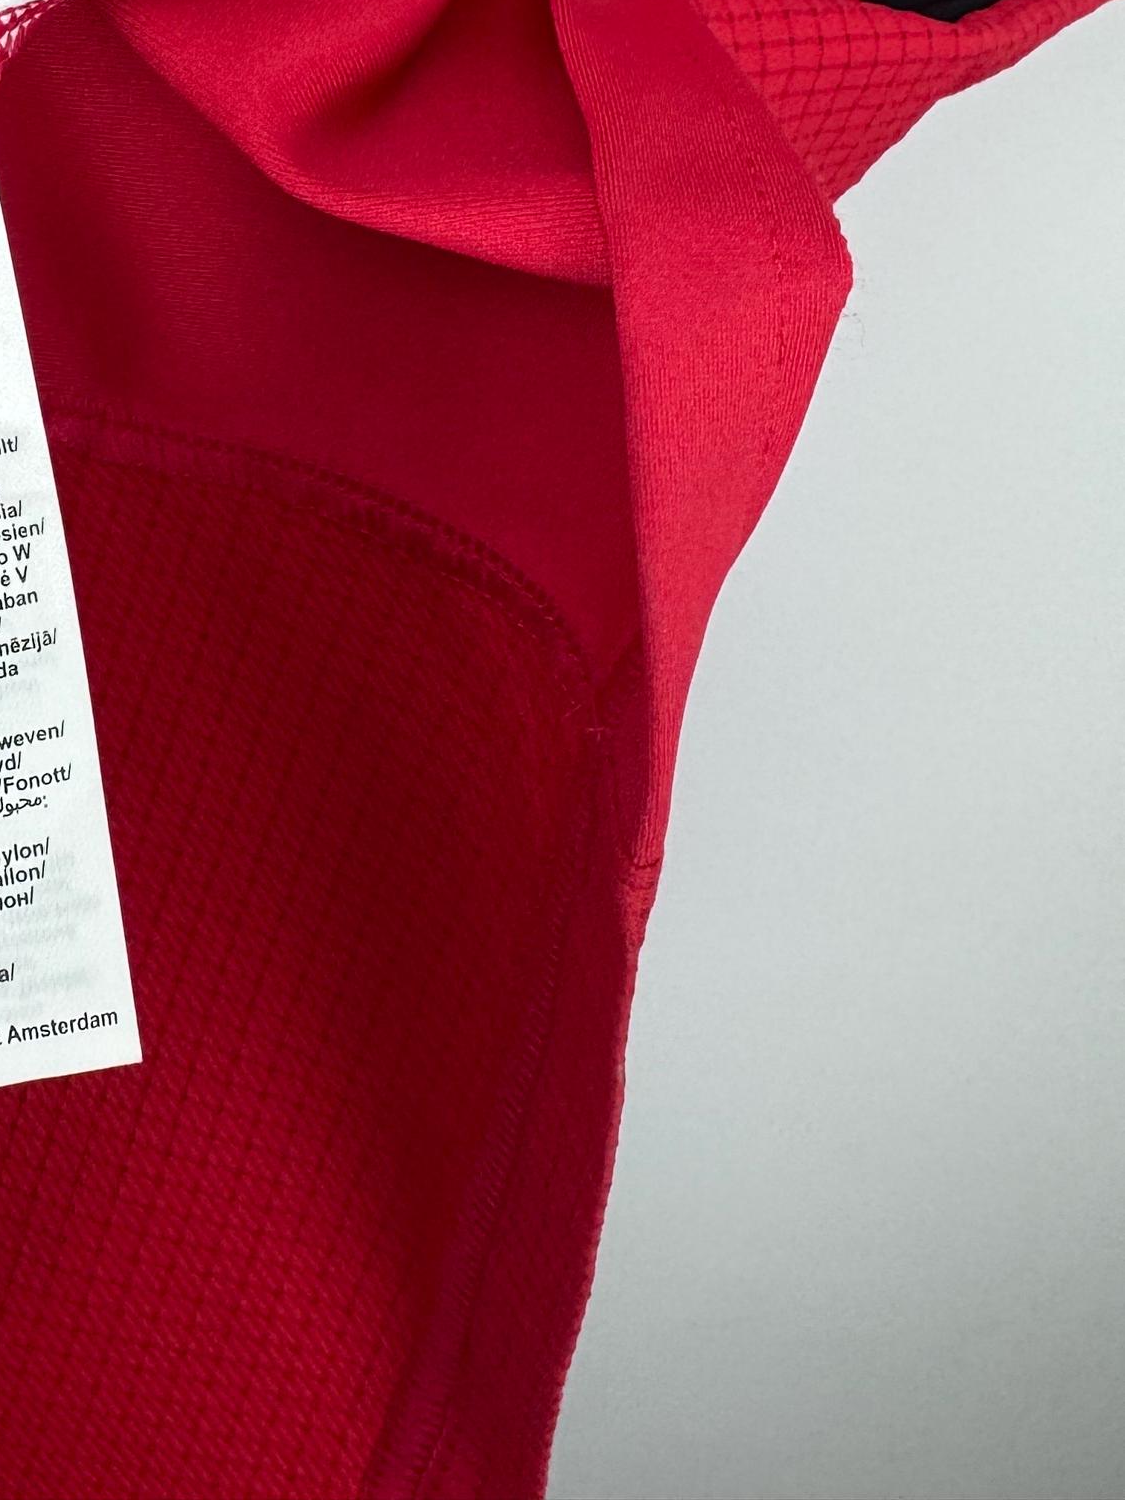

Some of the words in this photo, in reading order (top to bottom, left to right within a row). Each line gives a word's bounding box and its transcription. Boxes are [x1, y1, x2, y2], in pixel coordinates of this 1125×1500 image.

[12, 542, 30, 561] W
[15, 565, 27, 583] V
[8, 1011, 118, 1044] Amsterdam
